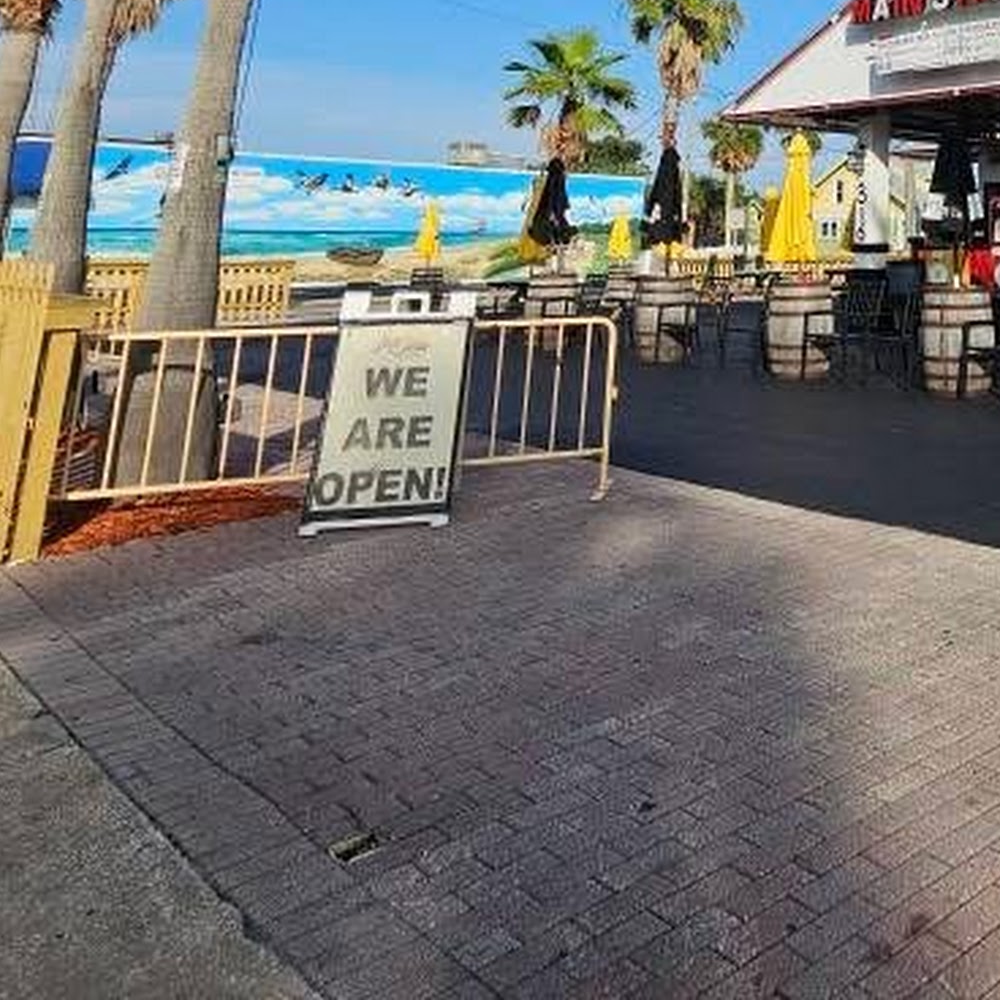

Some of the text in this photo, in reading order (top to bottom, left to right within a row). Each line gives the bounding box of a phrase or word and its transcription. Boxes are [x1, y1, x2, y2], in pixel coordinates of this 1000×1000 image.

[365, 366, 430, 397] WE
[342, 415, 433, 451] ARE
[312, 466, 446, 506] OPEN!
